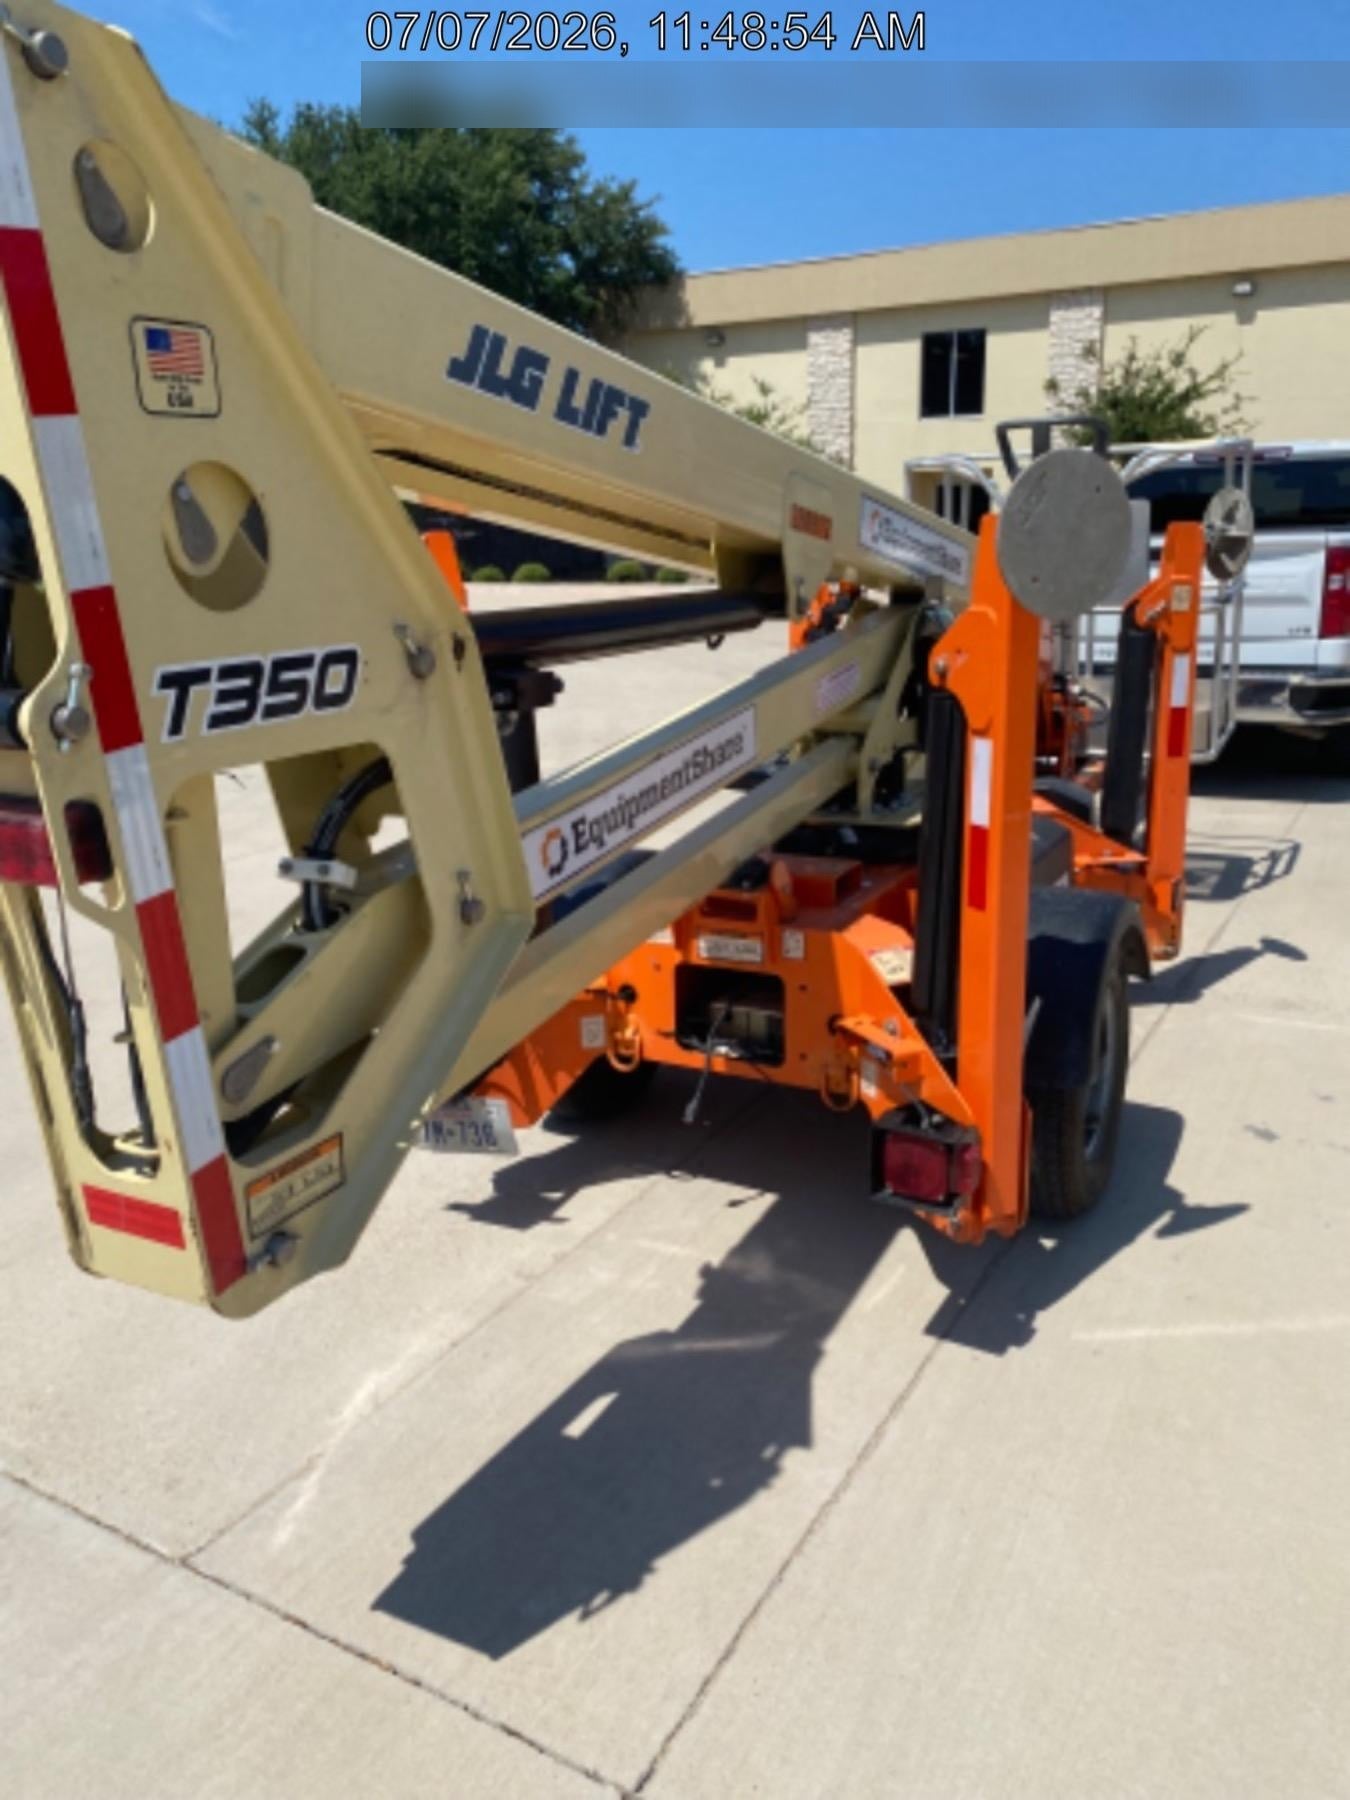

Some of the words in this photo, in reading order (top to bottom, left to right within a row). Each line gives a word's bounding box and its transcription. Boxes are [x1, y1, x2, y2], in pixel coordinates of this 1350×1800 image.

[447, 324, 549, 411] JLG
[553, 366, 650, 448] LIFT
[157, 648, 358, 738] T350
[571, 733, 743, 854] EquipmentShare
